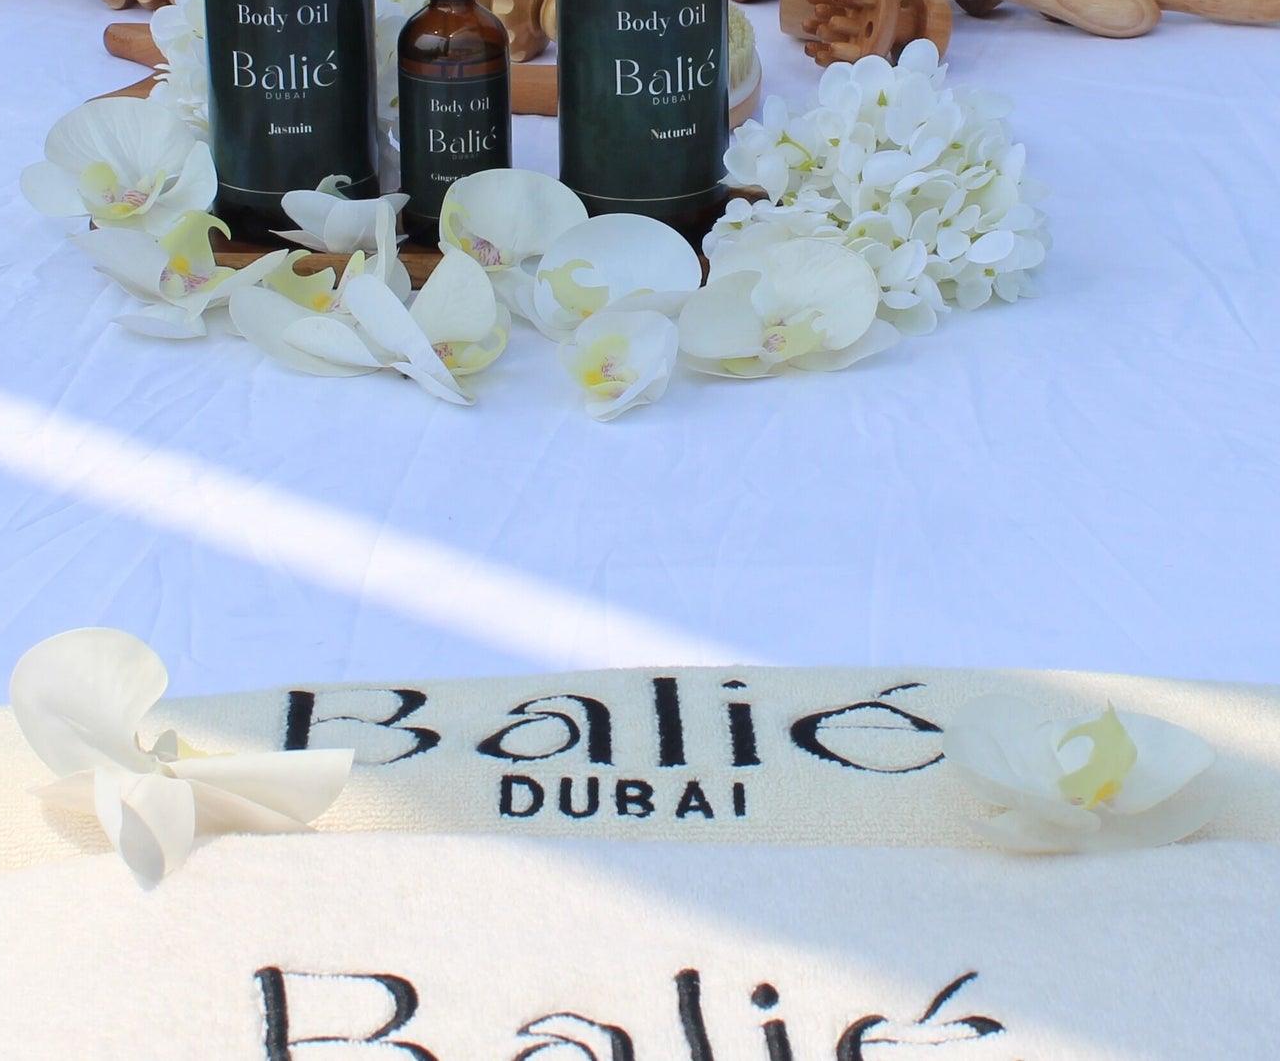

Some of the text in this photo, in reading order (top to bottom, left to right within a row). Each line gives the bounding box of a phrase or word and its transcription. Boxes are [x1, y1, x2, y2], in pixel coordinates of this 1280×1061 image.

[237, 3, 329, 33] Body Oil
[617, 3, 706, 37] Body Oil
[232, 50, 338, 90] Balié
[615, 48, 716, 96] Balié
[265, 91, 306, 100] DUBAI
[430, 97, 490, 117] Body Oil
[652, 95, 691, 106] DUBAI
[268, 122, 313, 135] Jasmin
[650, 123, 697, 140] Natural
[284, 676, 946, 774] Balié
[499, 775, 747, 820] DUBAI
